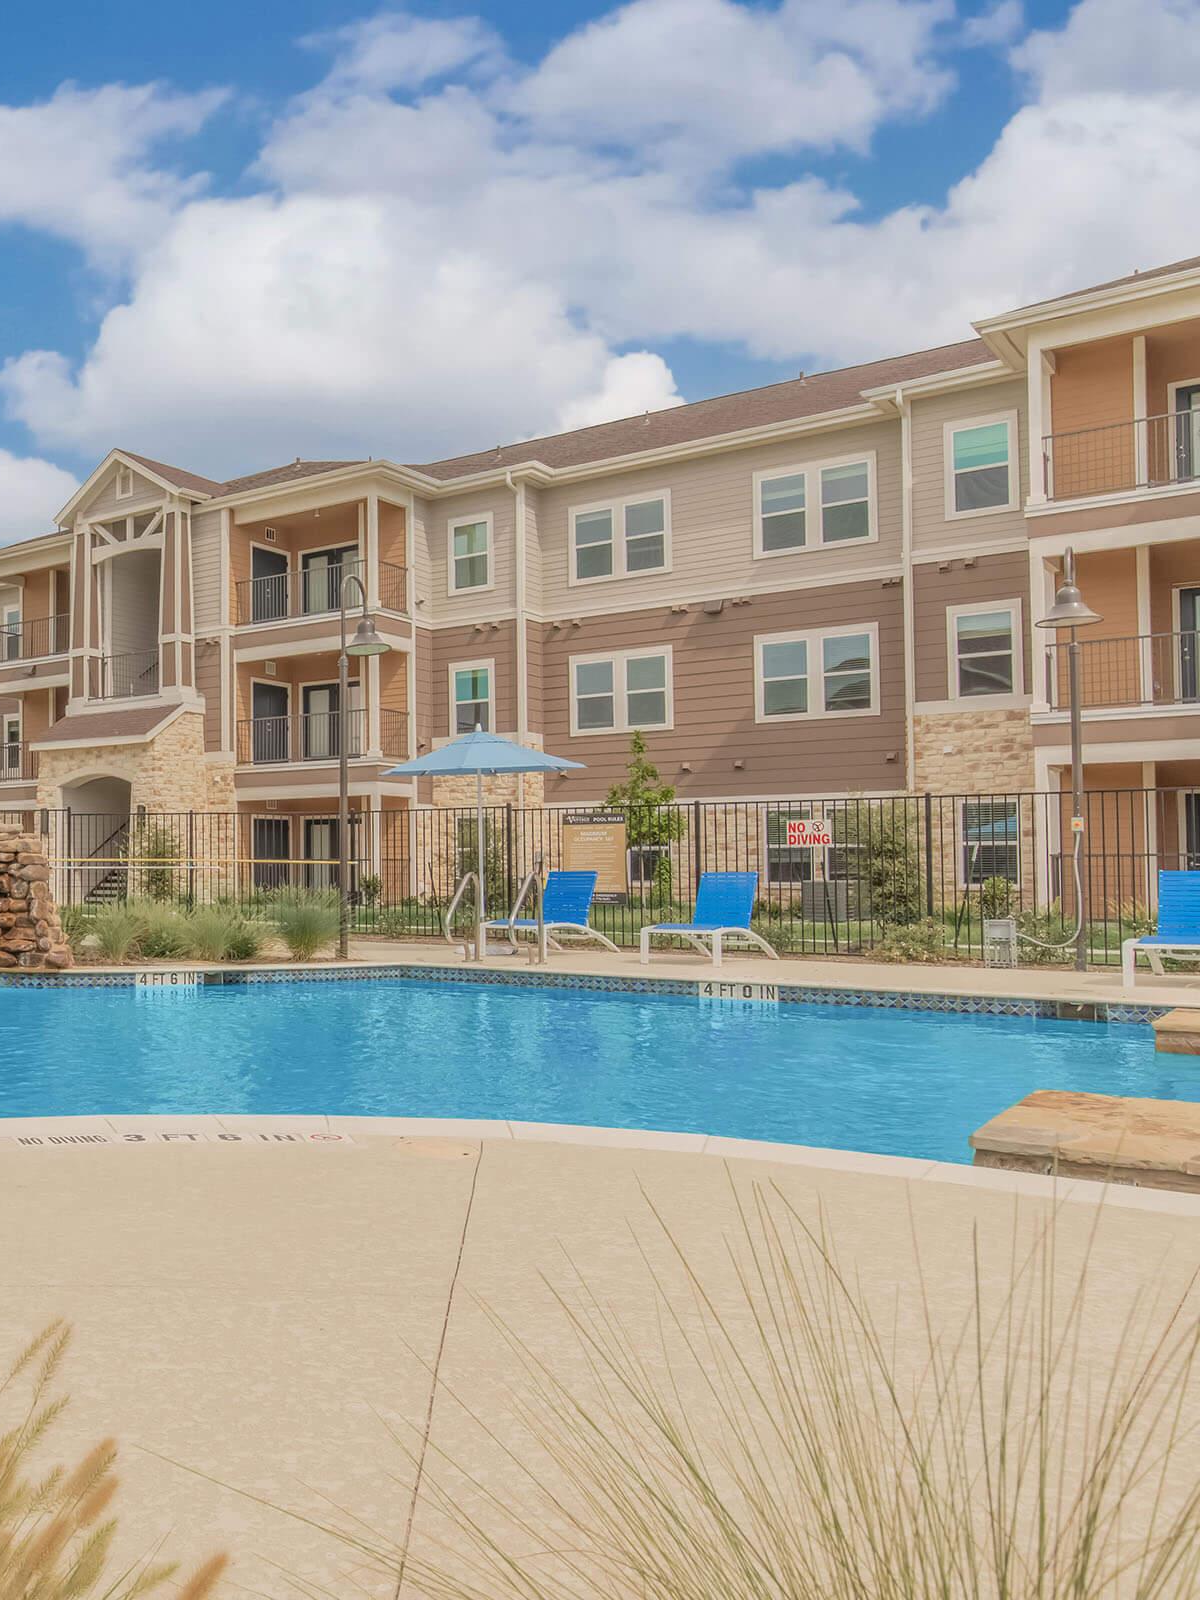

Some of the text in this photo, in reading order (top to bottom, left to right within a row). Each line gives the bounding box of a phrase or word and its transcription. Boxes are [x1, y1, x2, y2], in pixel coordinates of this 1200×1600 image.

[788, 822, 806, 832] NO
[788, 833, 831, 845] DIVING
[140, 972, 195, 985] 4 FT 6 IN
[704, 982, 713, 996] 4
[720, 983, 736, 997] FT
[761, 984, 775, 1000] IN
[18, 1133, 297, 1146] NO DIVING 3 FT 6 IN
